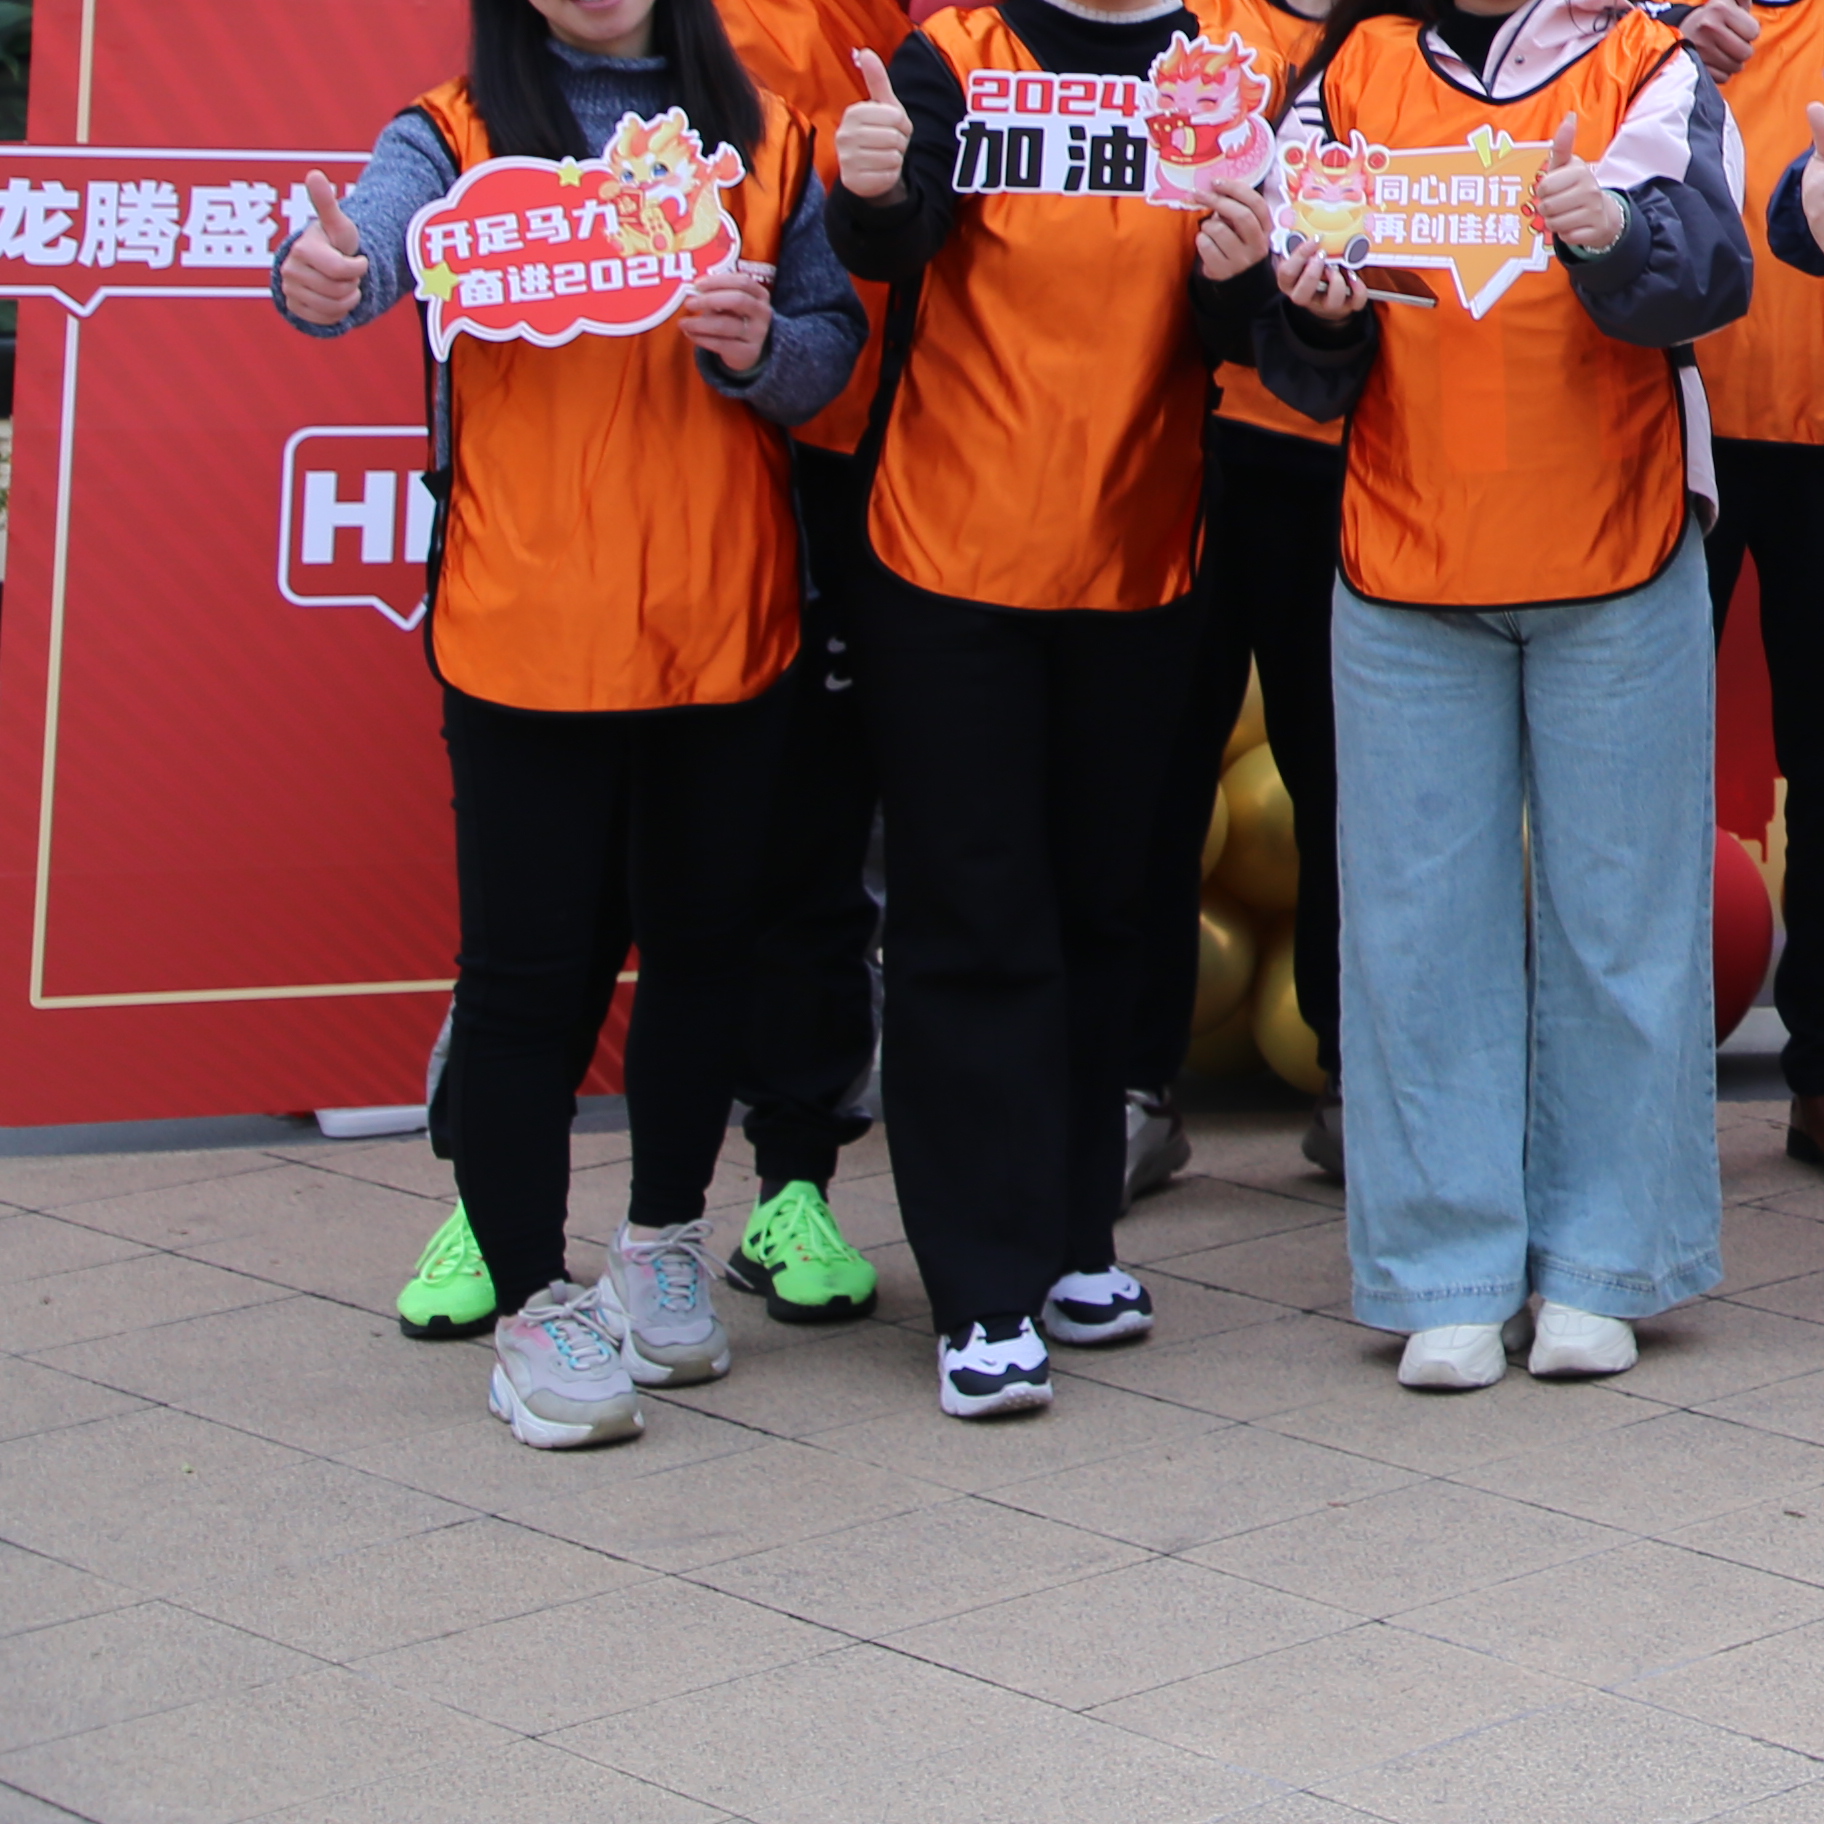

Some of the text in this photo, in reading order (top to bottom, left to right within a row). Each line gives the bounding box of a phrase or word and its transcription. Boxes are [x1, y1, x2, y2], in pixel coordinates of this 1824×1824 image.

[971, 77, 1140, 118] 2024
[956, 120, 1149, 192] 加油
[1373, 174, 1524, 207] 同心同行
[424, 198, 621, 264] 开足马力
[1371, 212, 1523, 246] 再创佳绩
[457, 251, 698, 308] 奋进2024
